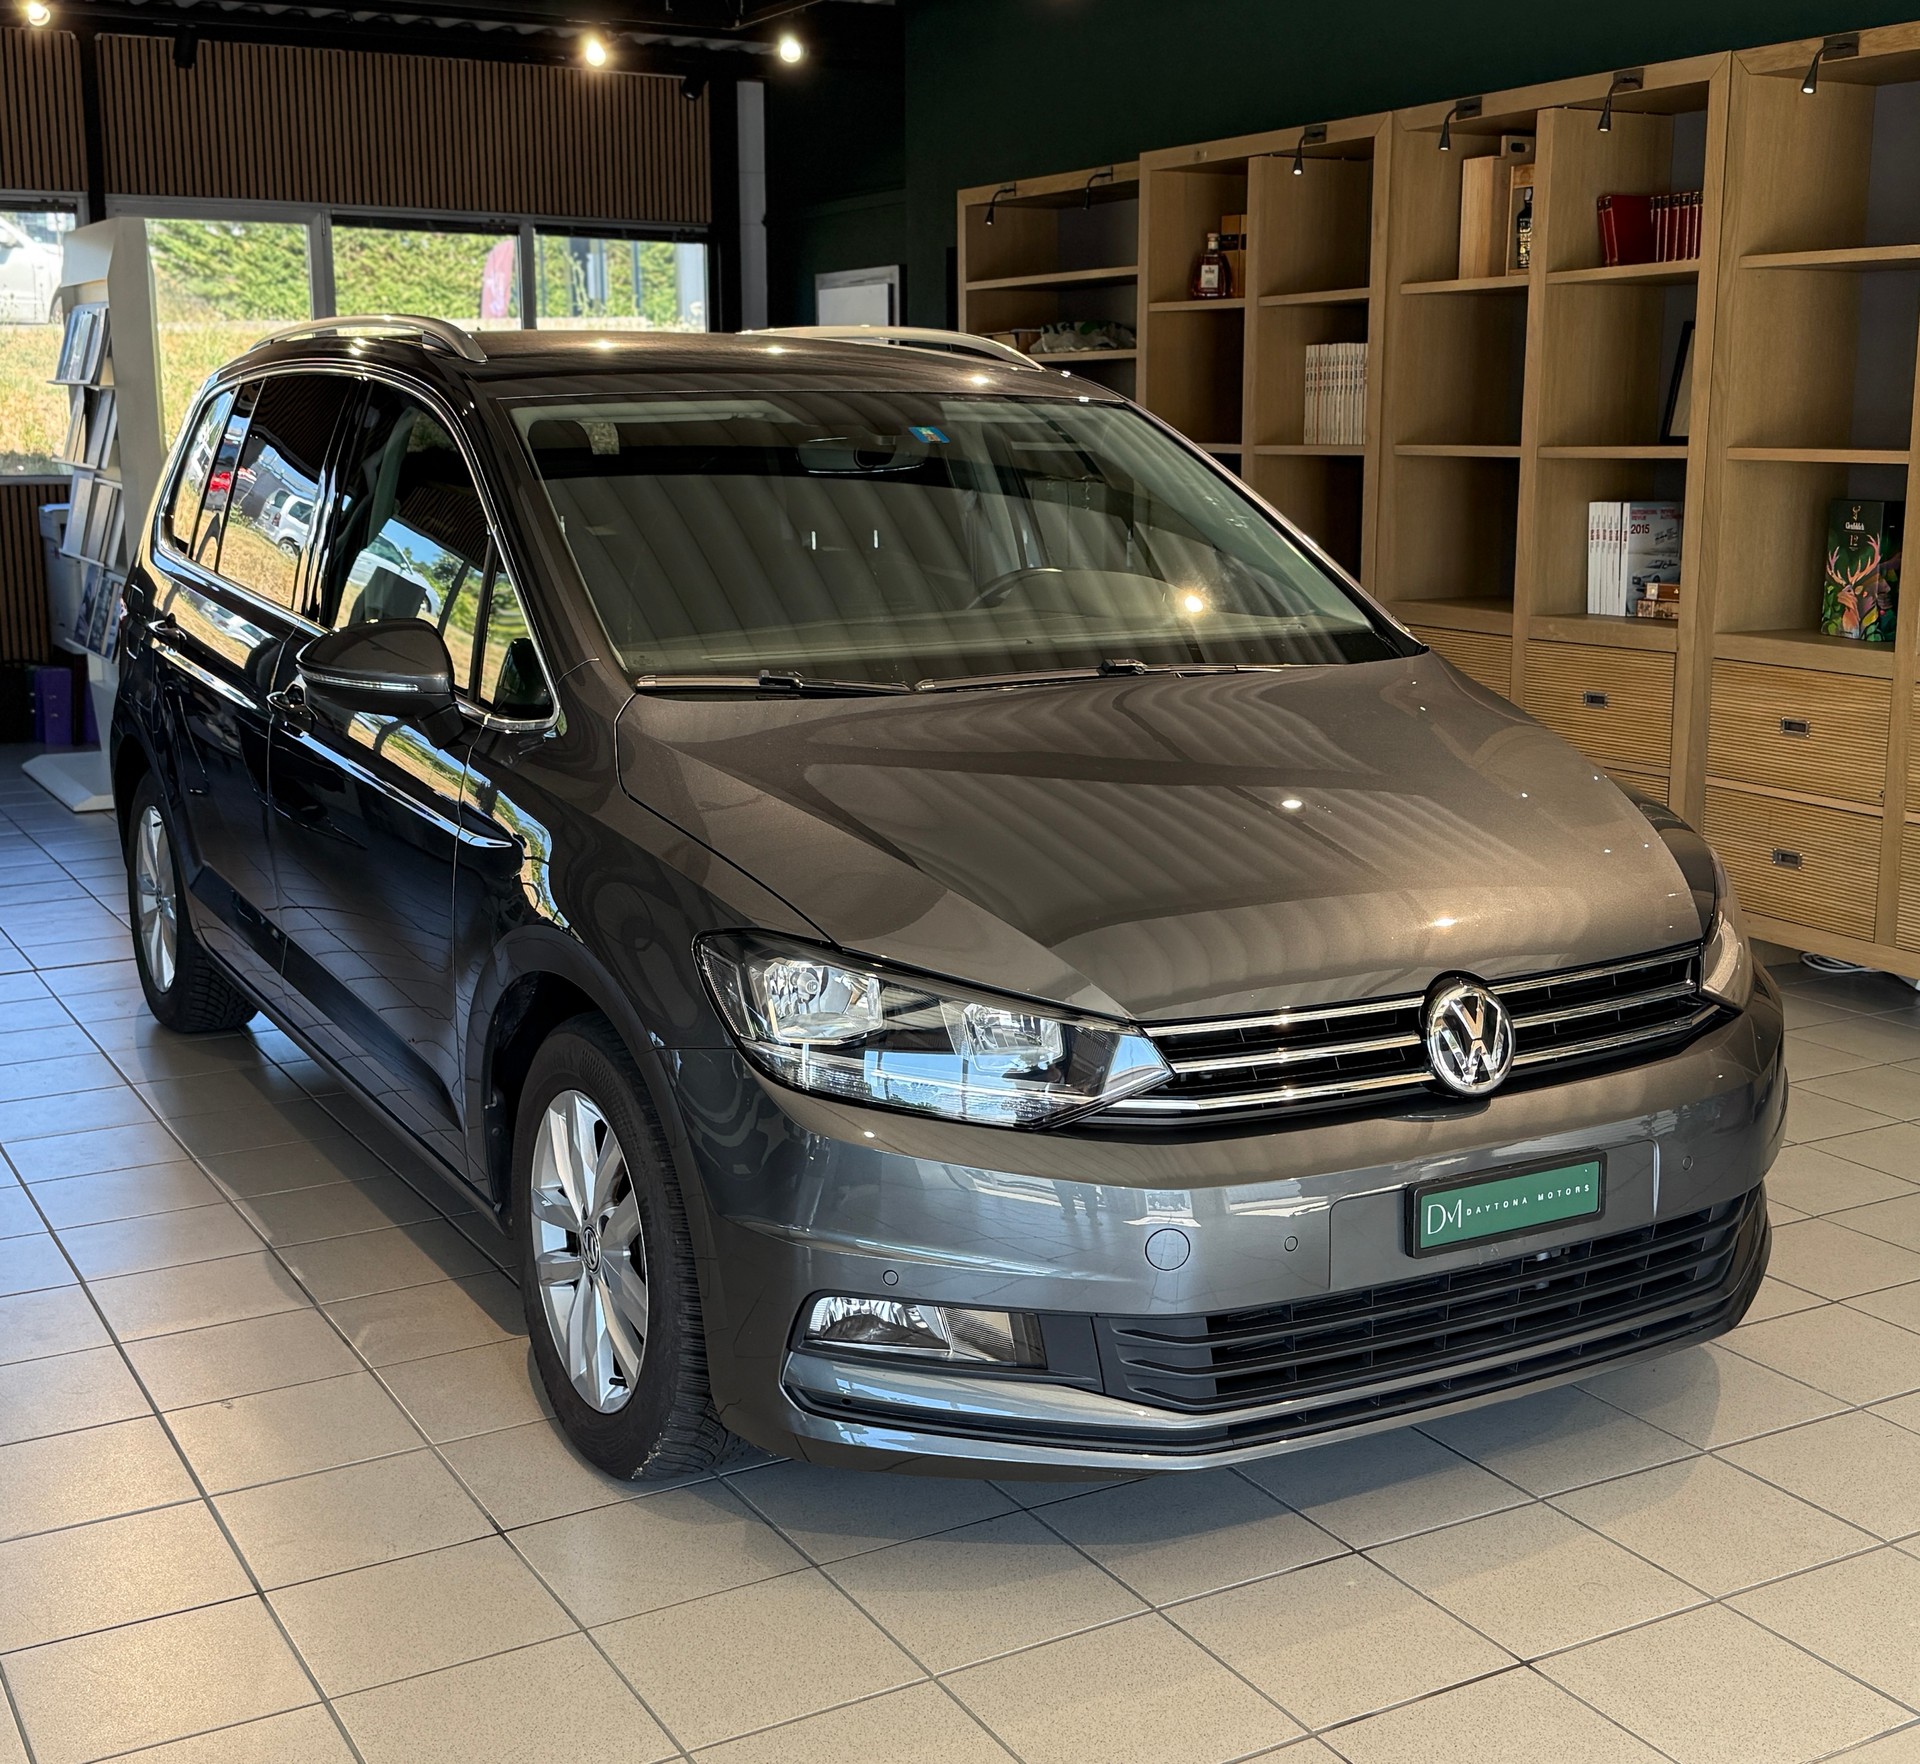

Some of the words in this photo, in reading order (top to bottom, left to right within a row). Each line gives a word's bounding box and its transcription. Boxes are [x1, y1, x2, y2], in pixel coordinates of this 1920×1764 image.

[1630, 523, 1650, 535] 2015
[1849, 534, 1859, 547] 12
[1466, 1197, 1528, 1216] DAYTONA
[1537, 1184, 1590, 1201] MOTORS
